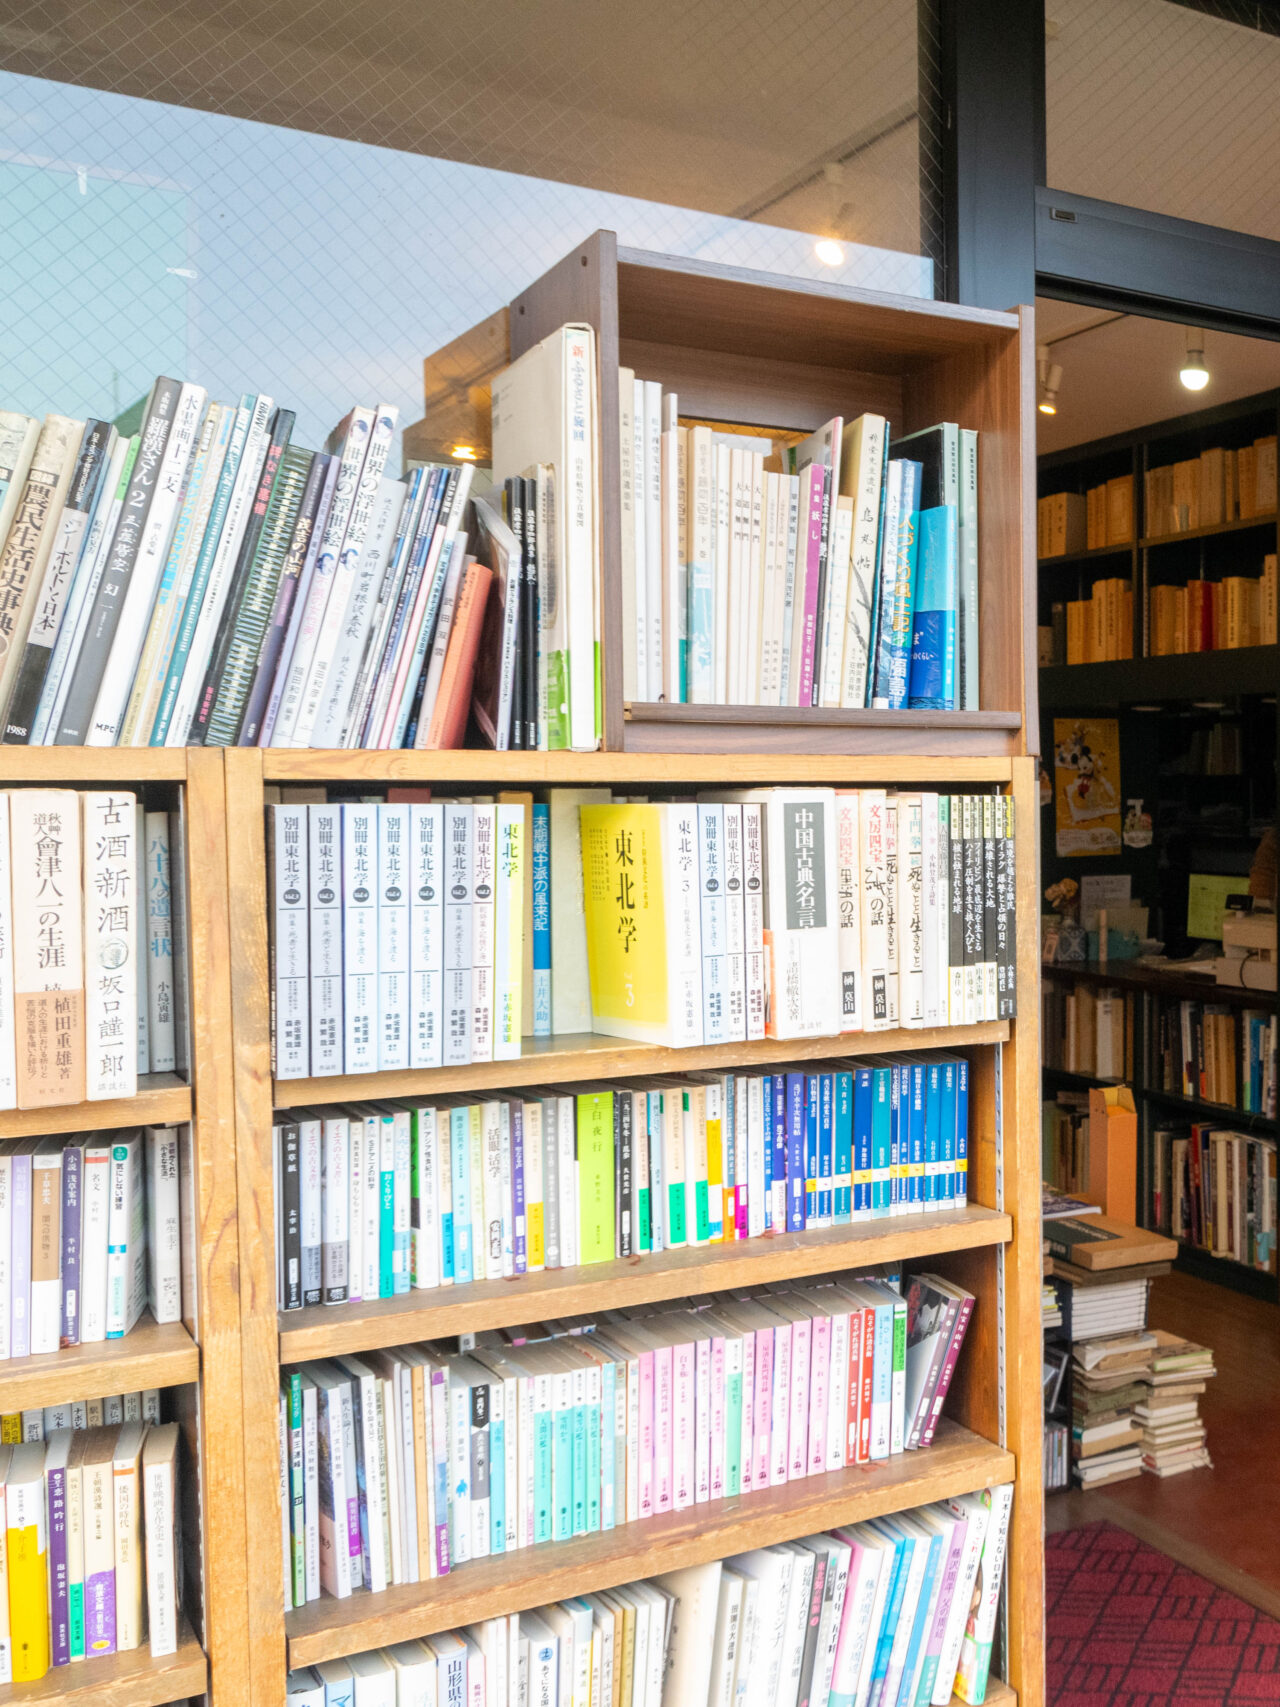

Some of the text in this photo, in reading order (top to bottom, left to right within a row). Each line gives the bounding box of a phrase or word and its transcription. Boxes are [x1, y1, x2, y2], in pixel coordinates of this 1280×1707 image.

[323, 444, 363, 547] 世界の浮世絵
[346, 442, 388, 544] 世界の浮世絵
[6, 723, 28, 738] 1988
[95, 722, 116, 735] MPC
[94, 797, 131, 934] 古酒新酒
[284, 817, 300, 887] 別冊東北学
[318, 817, 334, 887] 別冊東北学
[354, 817, 369, 886] 別冊東北学
[386, 817, 401, 885] 別冊東北学
[419, 817, 434, 885] 別冊東北学
[452, 817, 467, 884] 別冊東北学
[476, 816, 491, 885] 別冊東北学
[678, 819, 692, 871] 東北学
[705, 816, 717, 877] 別冊東北学
[727, 816, 739, 877] 別冊東北学
[747, 815, 759, 877] 別冊東北学
[869, 805, 883, 862] 文房四宝
[35, 835, 66, 970] 會津八一の生涯
[150, 837, 172, 958] 八十八の遺言状
[615, 829, 637, 953] 東北学
[98, 976, 125, 1077] 坂口謹一郎
